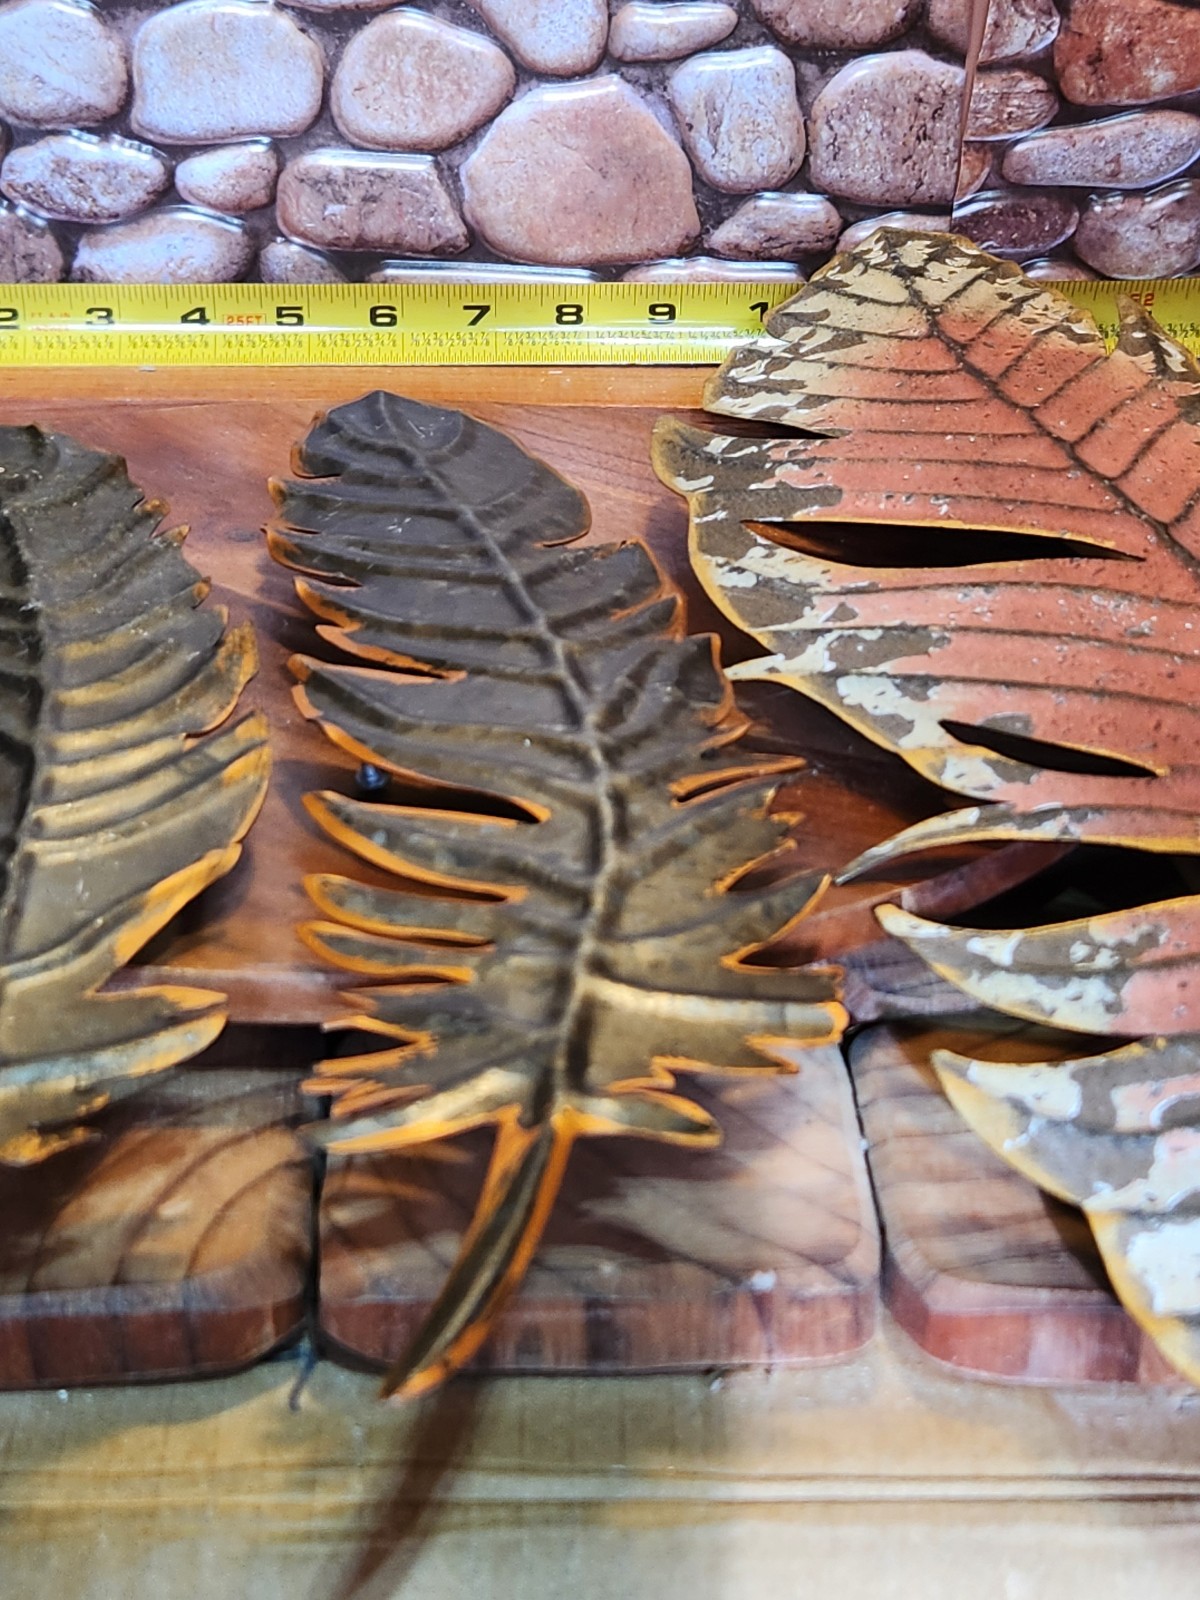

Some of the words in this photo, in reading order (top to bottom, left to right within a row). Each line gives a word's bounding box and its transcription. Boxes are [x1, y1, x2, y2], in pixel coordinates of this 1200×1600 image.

[85, 307, 115, 326] 3
[180, 306, 210, 325] 4
[275, 306, 304, 326] 5
[369, 305, 398, 327] 6
[462, 305, 491, 326] 7
[555, 304, 584, 325] 8
[648, 303, 677, 325] 9
[748, 302, 769, 323] 1
